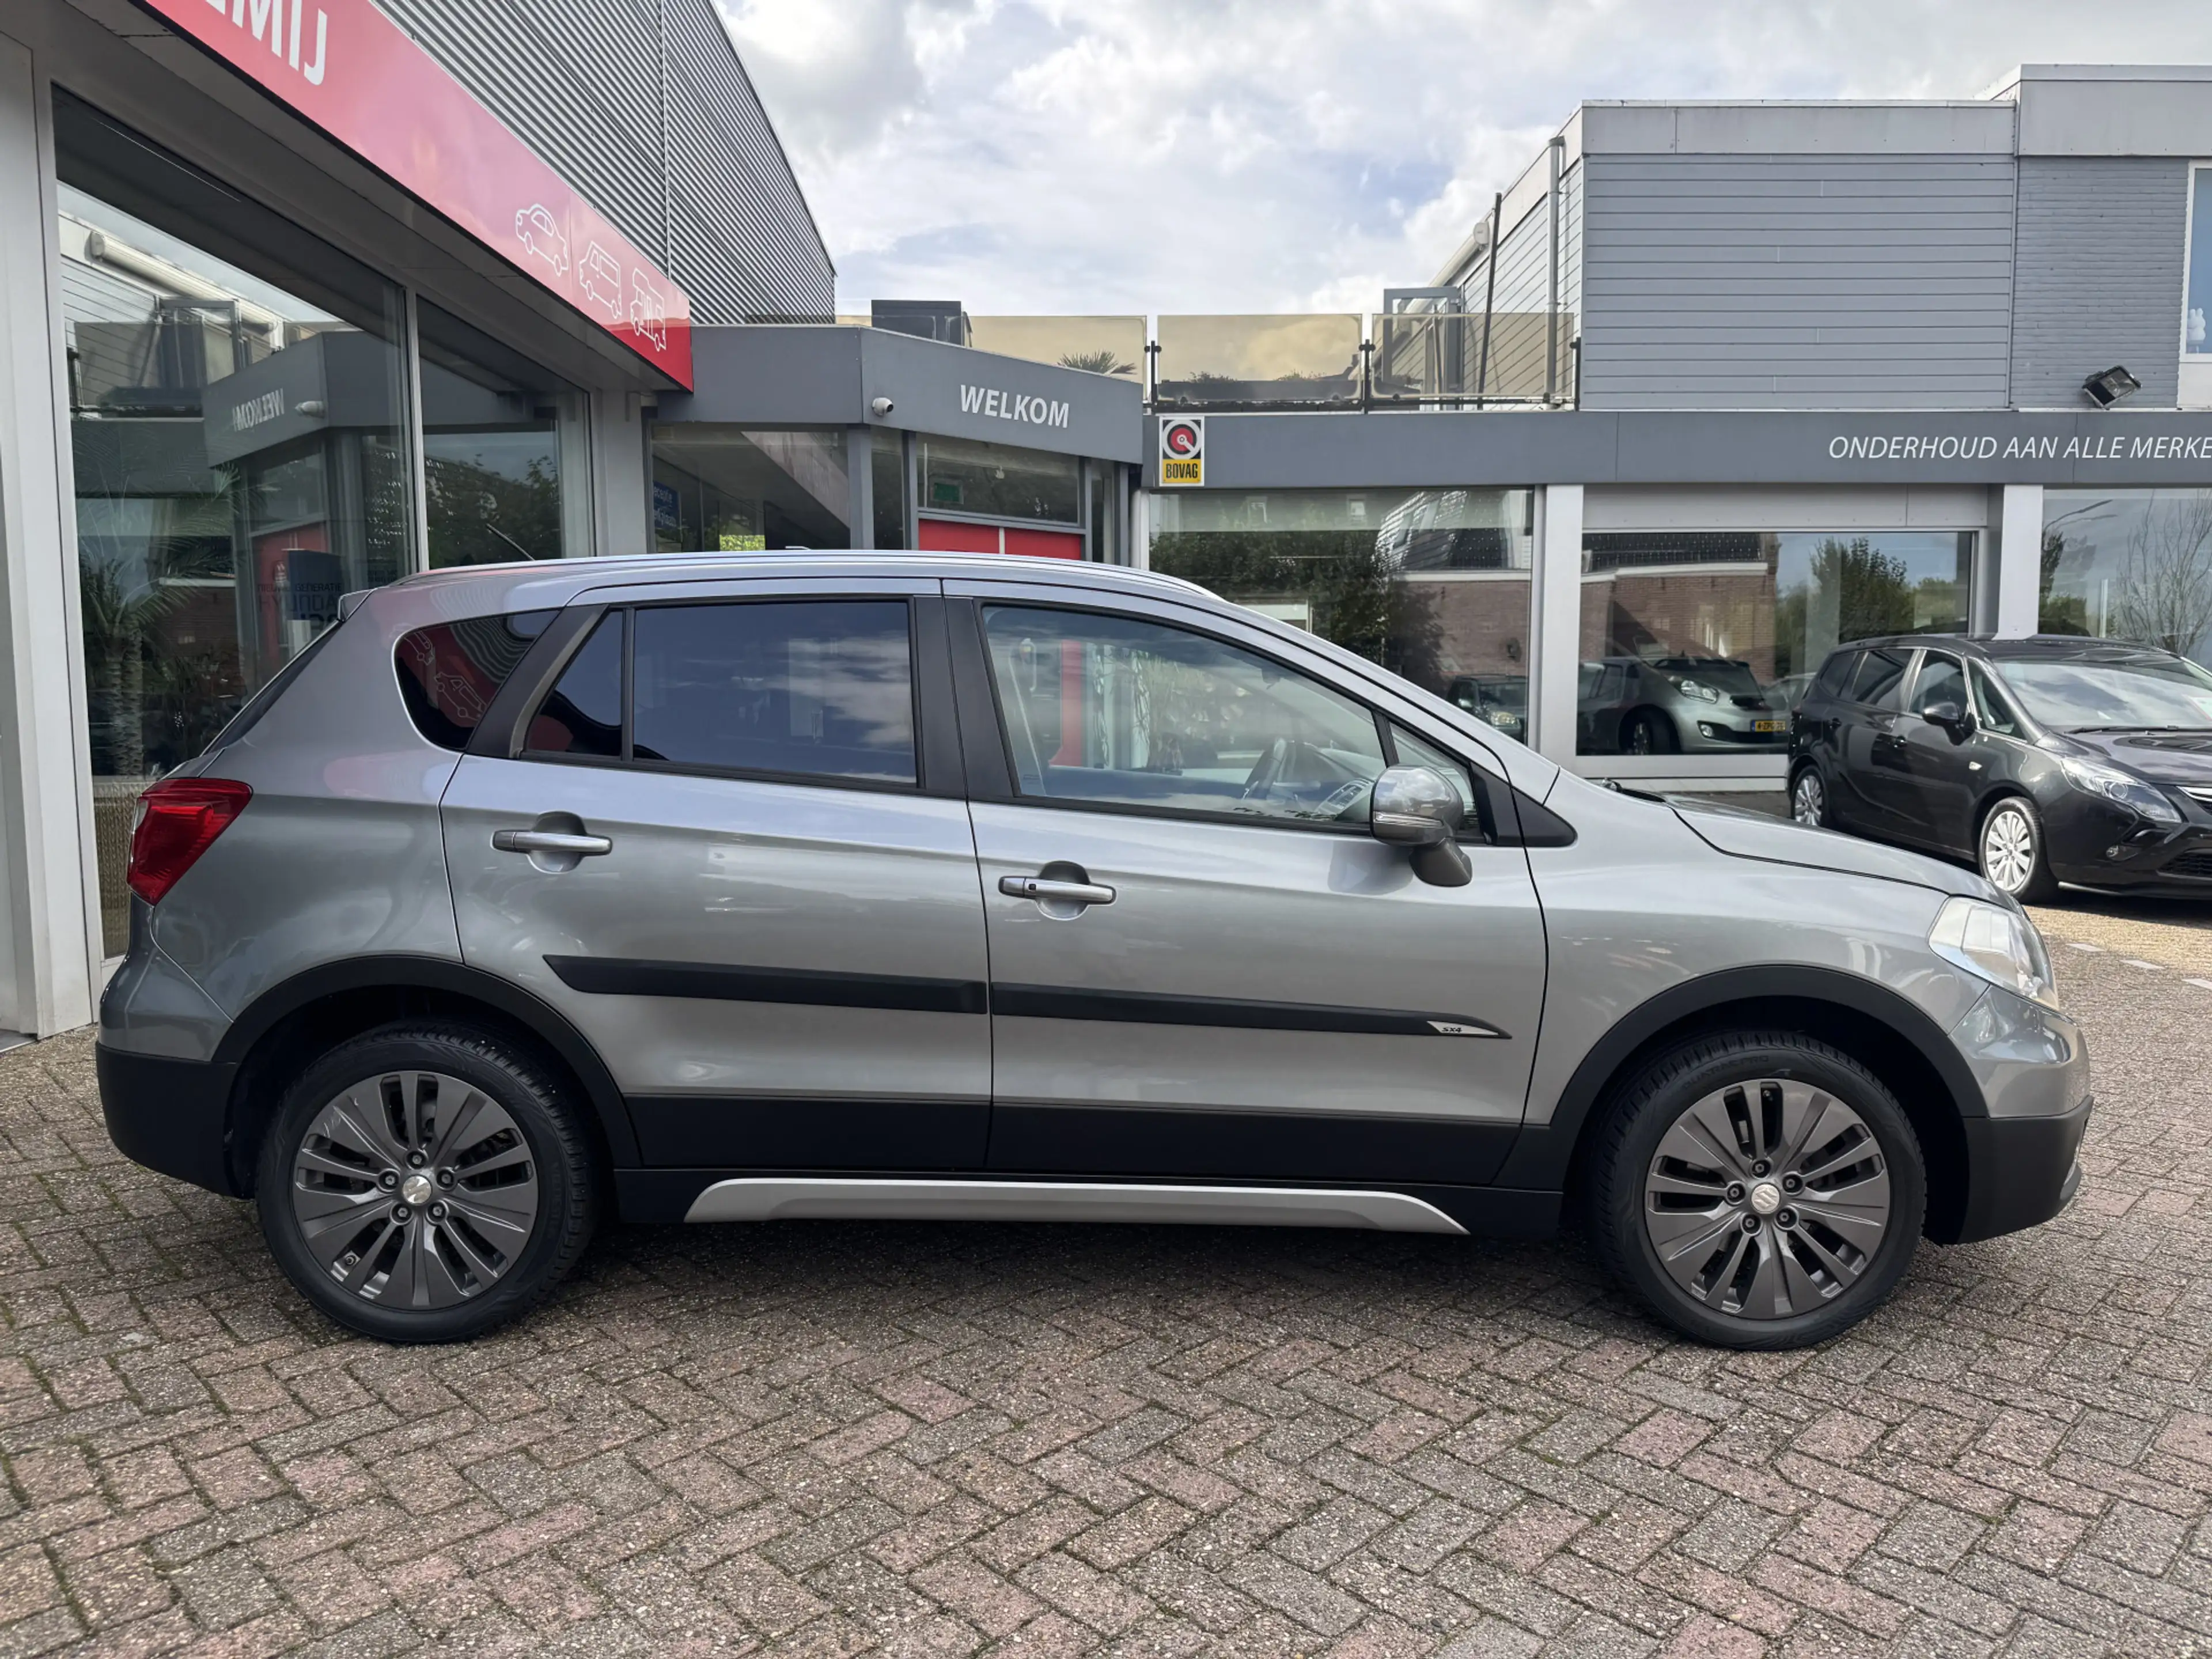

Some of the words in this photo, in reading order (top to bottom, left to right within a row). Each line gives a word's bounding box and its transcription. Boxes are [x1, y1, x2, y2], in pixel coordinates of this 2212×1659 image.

[961, 385, 1069, 428] WELKOM
[1829, 436, 1997, 459] ONDERHOUD
[2002, 436, 2059, 459] AAN
[2062, 436, 2125, 459] ALLE
[2130, 436, 2212, 459] MERKE
[1166, 463, 1198, 479] BOVAG
